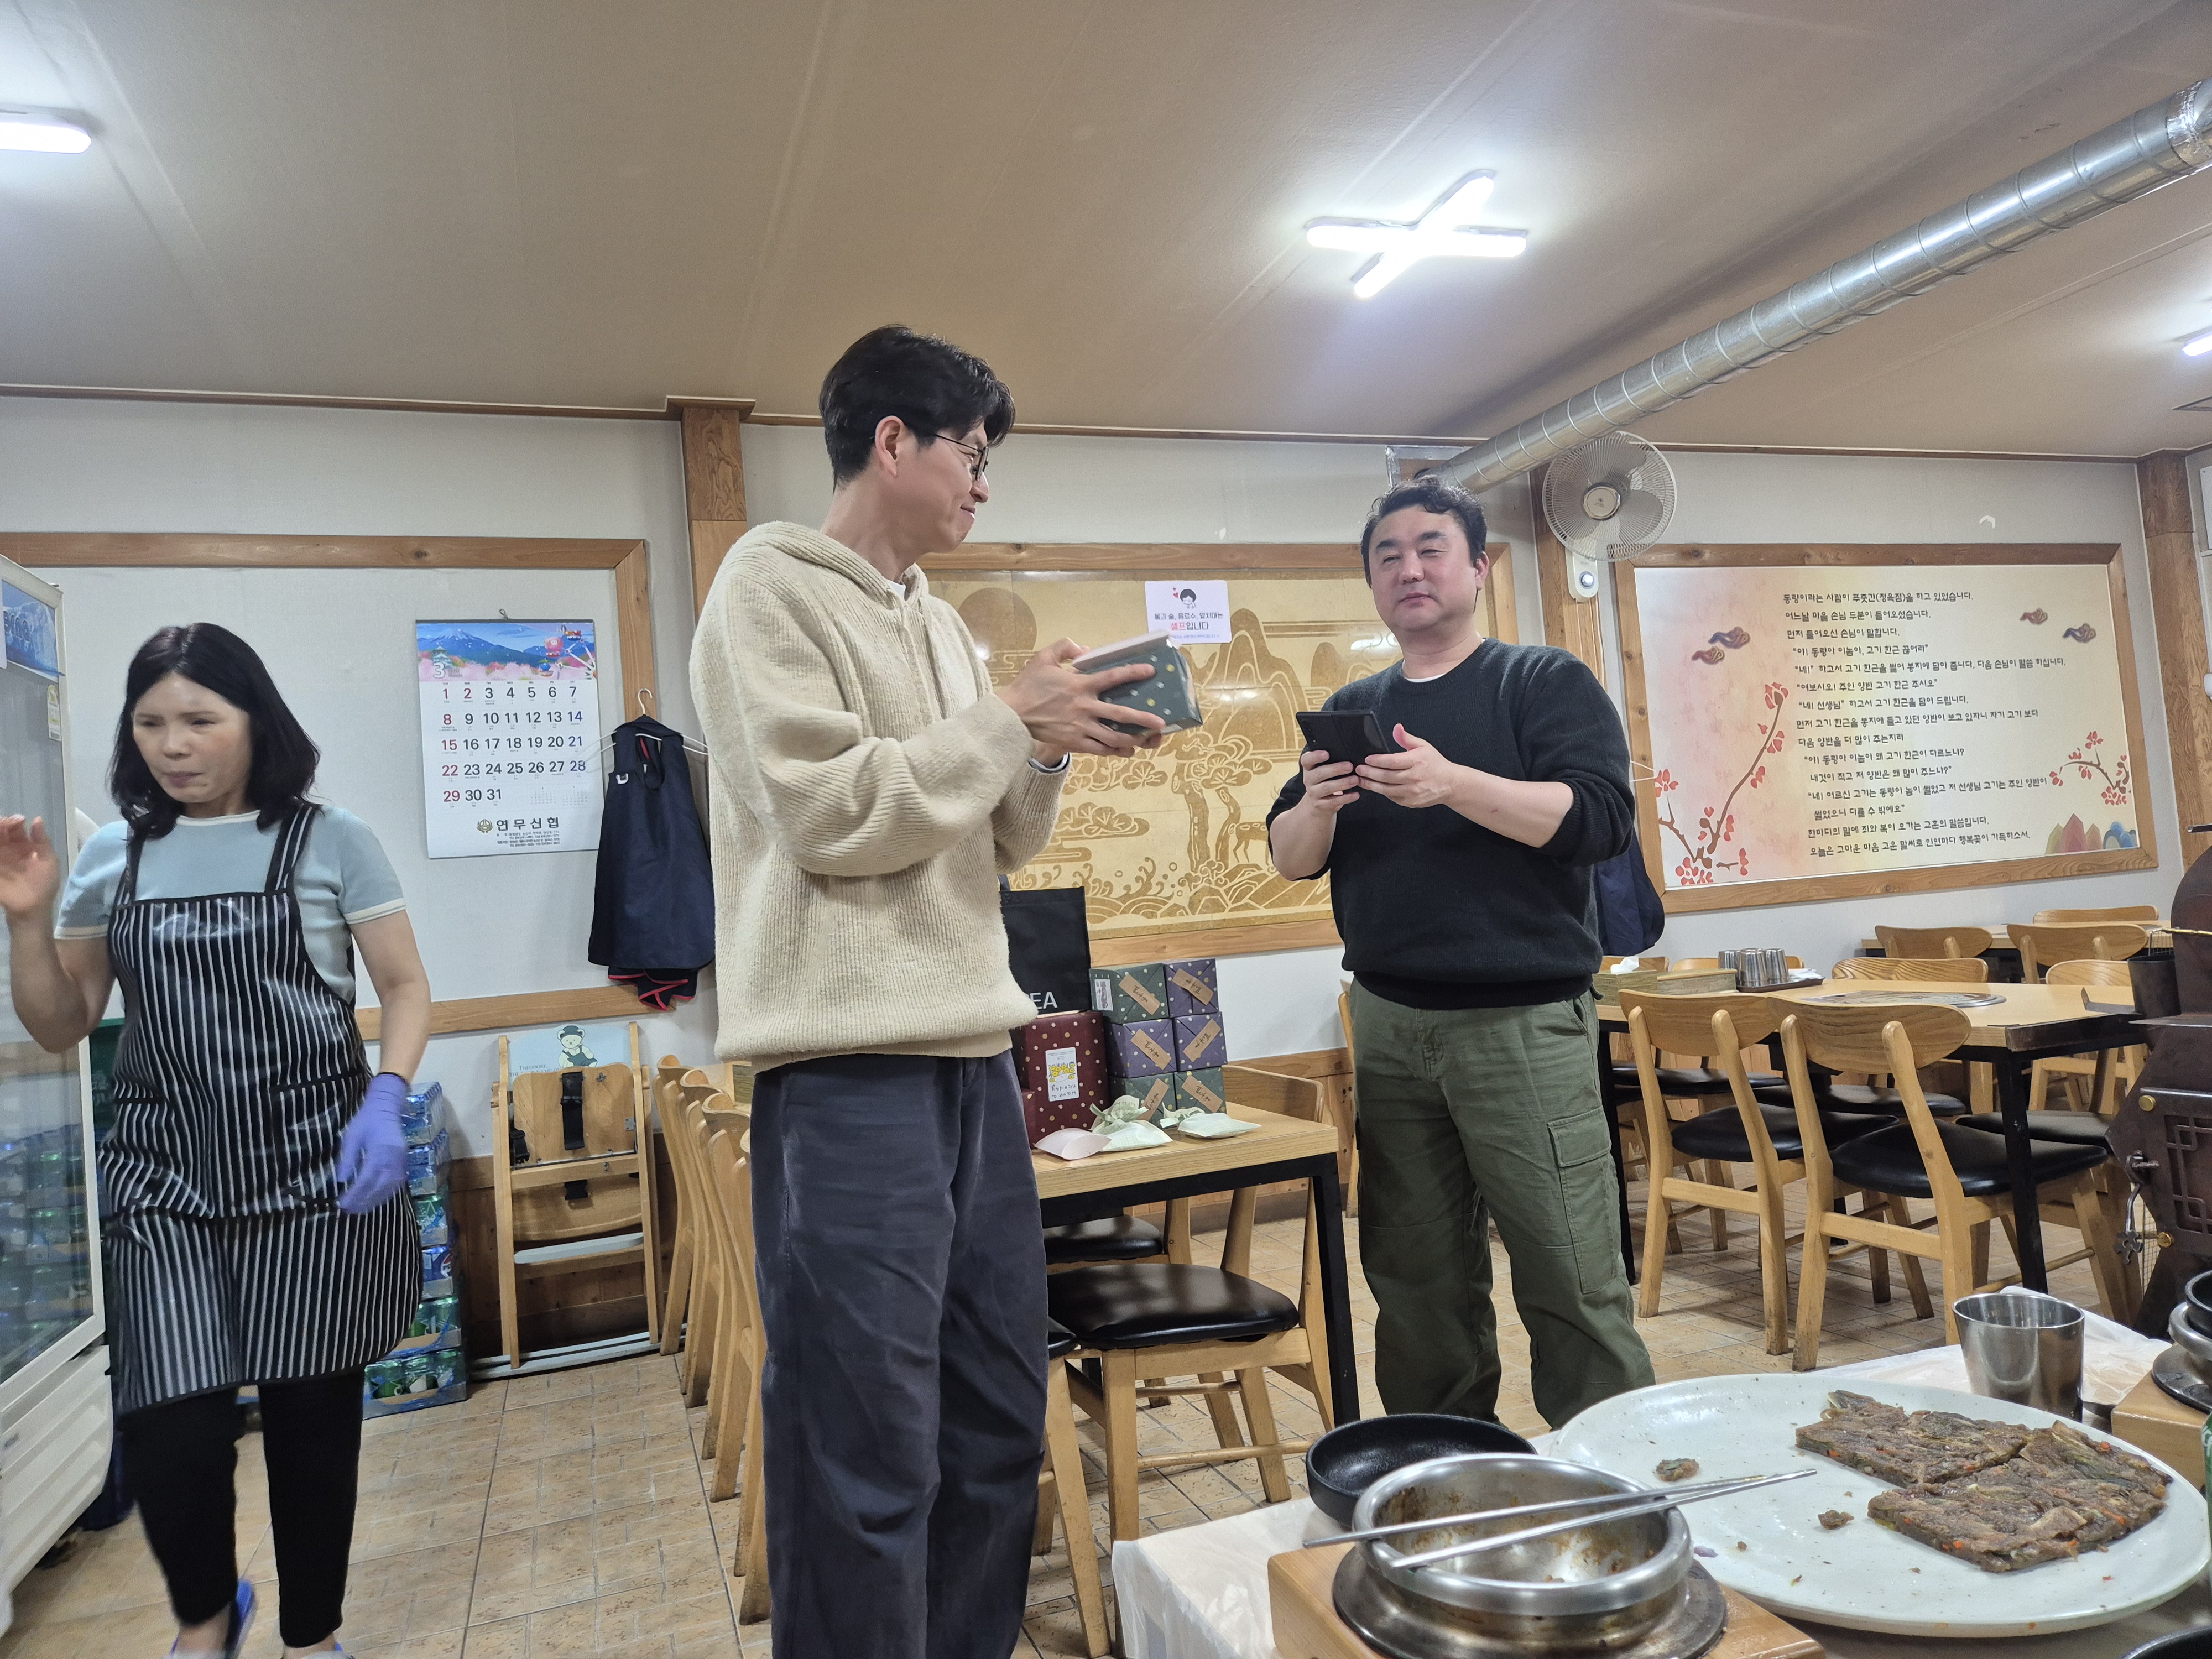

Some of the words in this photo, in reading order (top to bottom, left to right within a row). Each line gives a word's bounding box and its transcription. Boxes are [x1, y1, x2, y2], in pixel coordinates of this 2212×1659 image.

[1827, 593, 1850, 603] 사람이
[1934, 592, 1973, 602] 있었습니다.
[1786, 612, 1809, 622] 어느날
[1813, 611, 1828, 622] 마을
[1831, 611, 1846, 620] 손님
[1849, 611, 1872, 620] 두분이
[1875, 610, 1931, 620] 들어오셨습니다.
[1171, 622, 1209, 630] 셀프입니다
[1787, 630, 1803, 639] 먼저
[1806, 629, 1838, 639] 들어오신
[1841, 629, 1864, 638] 손님이
[1885, 645, 1900, 654] 한근
[1818, 665, 1842, 673] 하고서
[1845, 664, 1861, 672] 고기
[1863, 663, 1887, 673] 한근을
[1890, 662, 1904, 673] 썰어
[1907, 662, 1929, 672] 봉지에
[1933, 661, 1947, 671] 담아
[1977, 660, 1992, 670] 다음
[1995, 659, 2016, 669] 손님이
[2019, 659, 2033, 669] 말씀
[2035, 658, 2066, 667] 하십니다.
[1839, 682, 1855, 691] 주인
[1858, 682, 1872, 691] 양반
[1876, 681, 1891, 689] 고기
[1893, 680, 1909, 689] 한근
[442, 688, 448, 700] 1
[463, 688, 472, 699] 2
[485, 687, 493, 699] 3
[507, 687, 515, 698] 4
[528, 687, 536, 698] 5
[548, 686, 557, 697] 6
[569, 686, 577, 697] 7
[1849, 699, 1872, 707] 하고서
[1875, 698, 1890, 707] 고기
[1893, 697, 1916, 707] 한근을
[1919, 697, 1933, 707] 담아
[1936, 695, 1969, 706] 드립니다.
[443, 713, 452, 725] 8
[465, 713, 473, 724] 9
[483, 712, 499, 724] 10
[504, 712, 519, 723] 11
[525, 711, 541, 723] 12
[546, 711, 562, 723] 13
[567, 711, 583, 722] 14
[1797, 719, 1812, 729] 먼저
[1815, 719, 1832, 727] 고기
[1834, 718, 1858, 728] 한근을
[1861, 717, 1884, 728] 봉지에
[1887, 716, 1902, 726] 들고
[1905, 715, 1920, 724] 있던
[1922, 714, 1945, 724] 양반이
[1965, 712, 1987, 722] 있자니
[1990, 711, 2005, 719] 자기
[2007, 710, 2022, 718] 고기
[2024, 709, 2038, 718] 보다
[442, 739, 458, 751] 15
[463, 738, 479, 750] 16
[485, 738, 500, 749] 17
[506, 737, 522, 749] 18
[528, 737, 543, 748] 19
[547, 736, 564, 747] 20
[568, 735, 582, 747] 21
[1798, 738, 1814, 748] 다음
[1817, 737, 1841, 747] 양반을
[1855, 735, 1870, 745] 많이
[1886, 752, 1901, 760] 고기
[1904, 750, 1927, 760] 한근이
[442, 764, 459, 776] 22
[463, 764, 481, 776] 23
[485, 763, 502, 775] 24
[507, 762, 524, 774] 25
[528, 761, 545, 773] 26
[549, 761, 565, 773] 27
[570, 760, 586, 772] 28
[1810, 773, 1834, 783] 내것이
[1838, 772, 1853, 781] 적고
[1866, 769, 1890, 780] 양반은
[1892, 769, 1900, 777] 왜
[1903, 768, 1918, 779] 많이
[1827, 790, 1850, 799] 어르신
[1853, 789, 1876, 798] 고기는
[1905, 785, 1921, 796] 놈이
[1923, 784, 1946, 795] 썰었고
[1959, 782, 1981, 792] 선생님
[1984, 780, 2006, 789] 고기는
[2008, 779, 2023, 788] 주인
[2025, 777, 2047, 788] 양반이
[443, 790, 460, 802] 29
[465, 789, 482, 801] 30
[487, 789, 502, 800] 31
[1814, 808, 1846, 821] 썰었으니
[1849, 807, 1865, 817] 다를
[1868, 806, 1875, 815] 수
[1808, 827, 1840, 838] 한마디의
[1843, 826, 1859, 837] 말에
[1862, 824, 1877, 833] 죄와
[1880, 823, 1895, 833] 복이
[1898, 822, 1921, 830] 오가는
[1949, 816, 1989, 829] 말씀입니다.
[1810, 846, 1834, 857] 오늘은
[1837, 844, 1861, 853] 고마운
[1864, 842, 1879, 853] 마음
[1882, 841, 1897, 851] 고운
[1900, 839, 1923, 850] 말씨로
